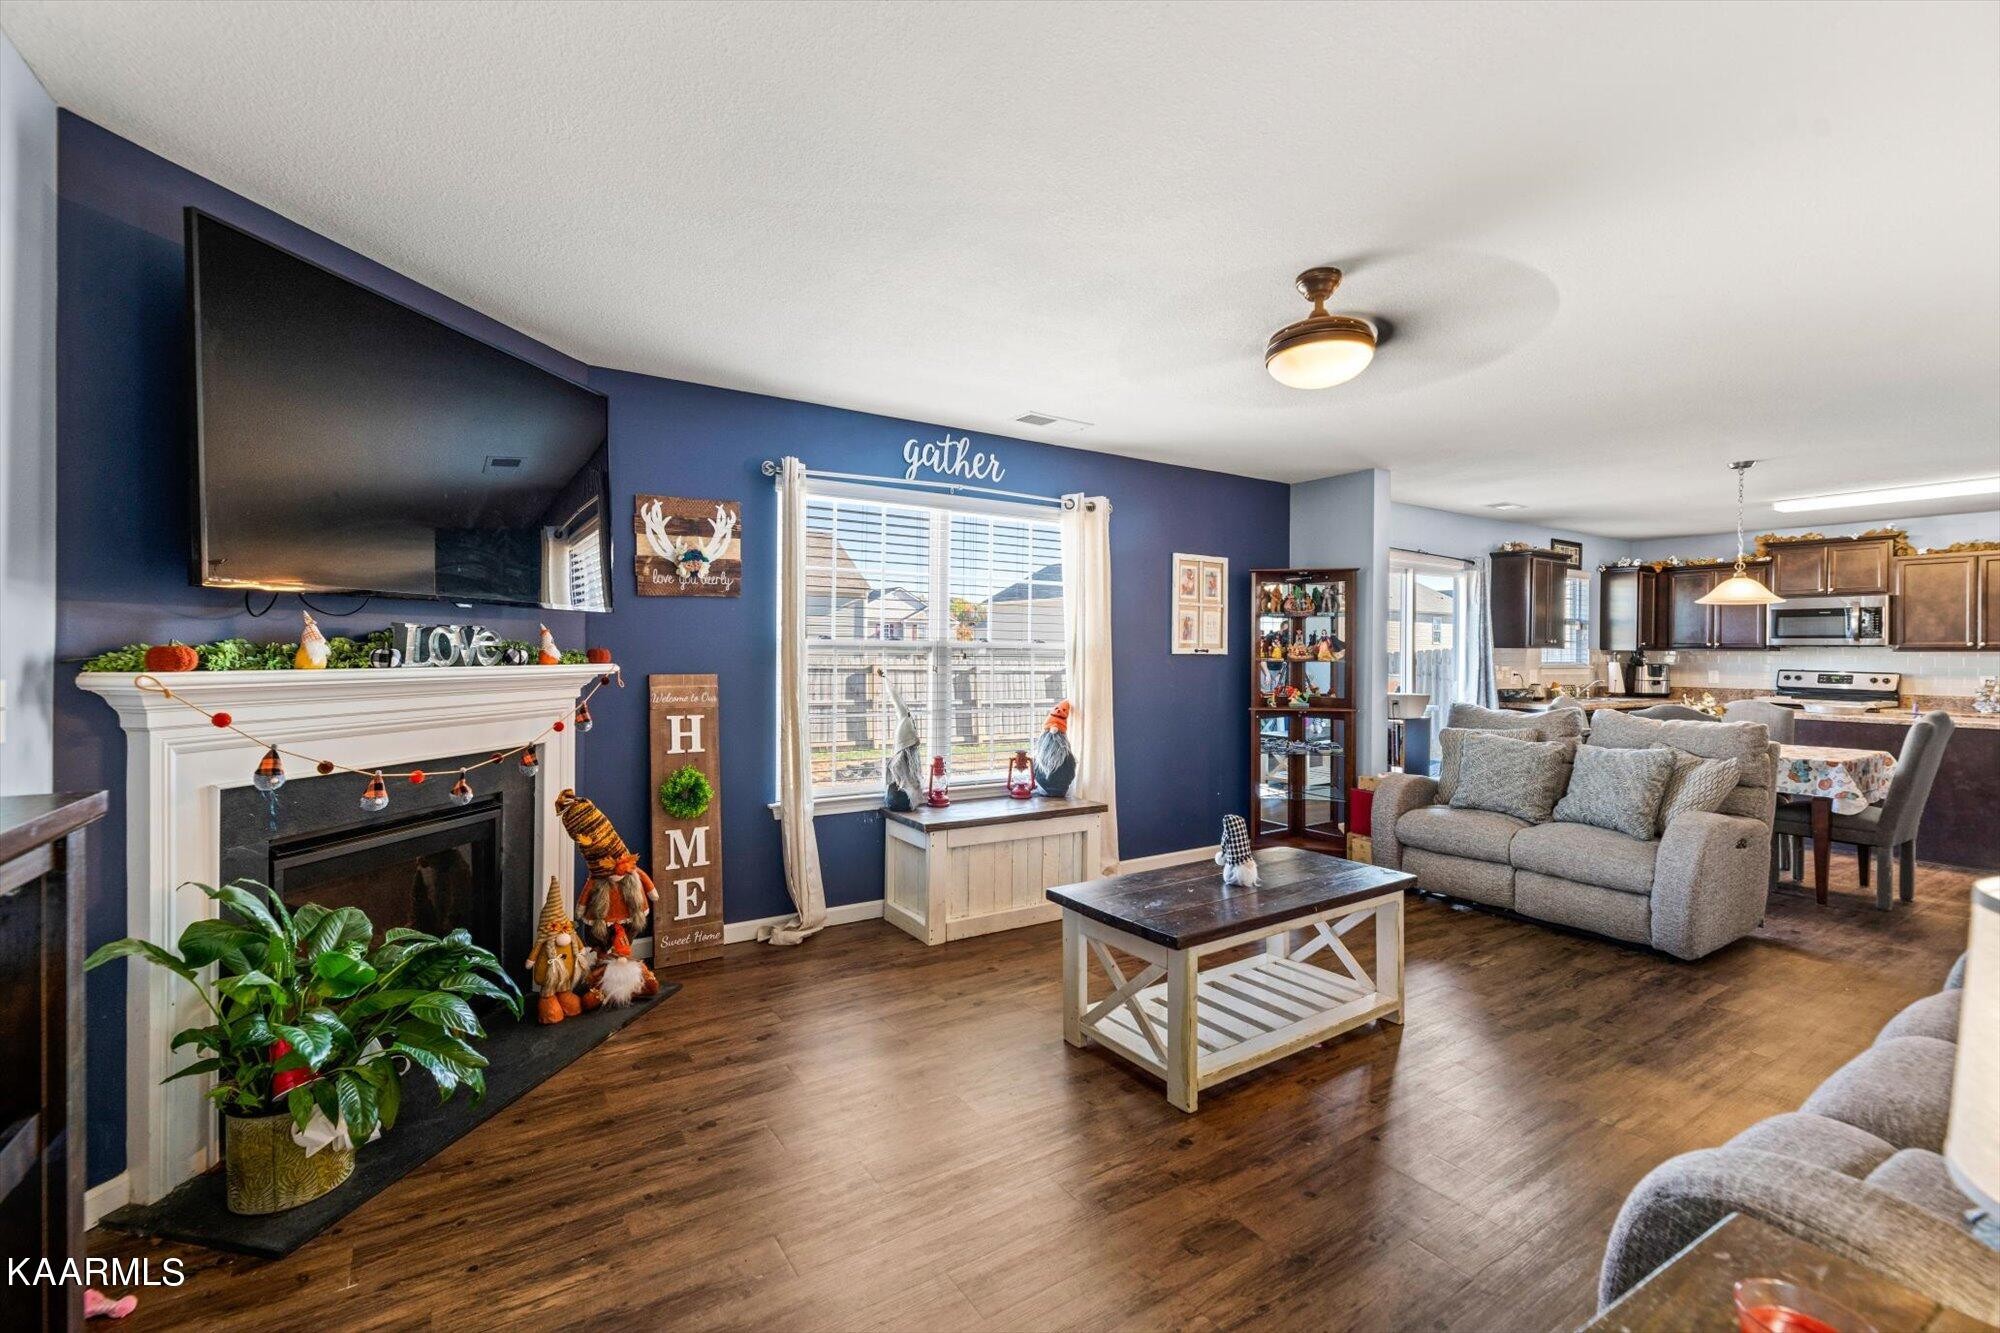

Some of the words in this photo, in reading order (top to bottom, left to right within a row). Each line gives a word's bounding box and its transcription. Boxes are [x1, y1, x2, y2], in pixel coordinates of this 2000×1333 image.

[903, 433, 1006, 483] gather
[652, 568, 675, 584] love
[679, 576, 699, 591] you
[651, 692, 689, 704] Welcome
[690, 693, 699, 703] to
[660, 934, 693, 949] Sweet
[694, 930, 721, 944] Home
